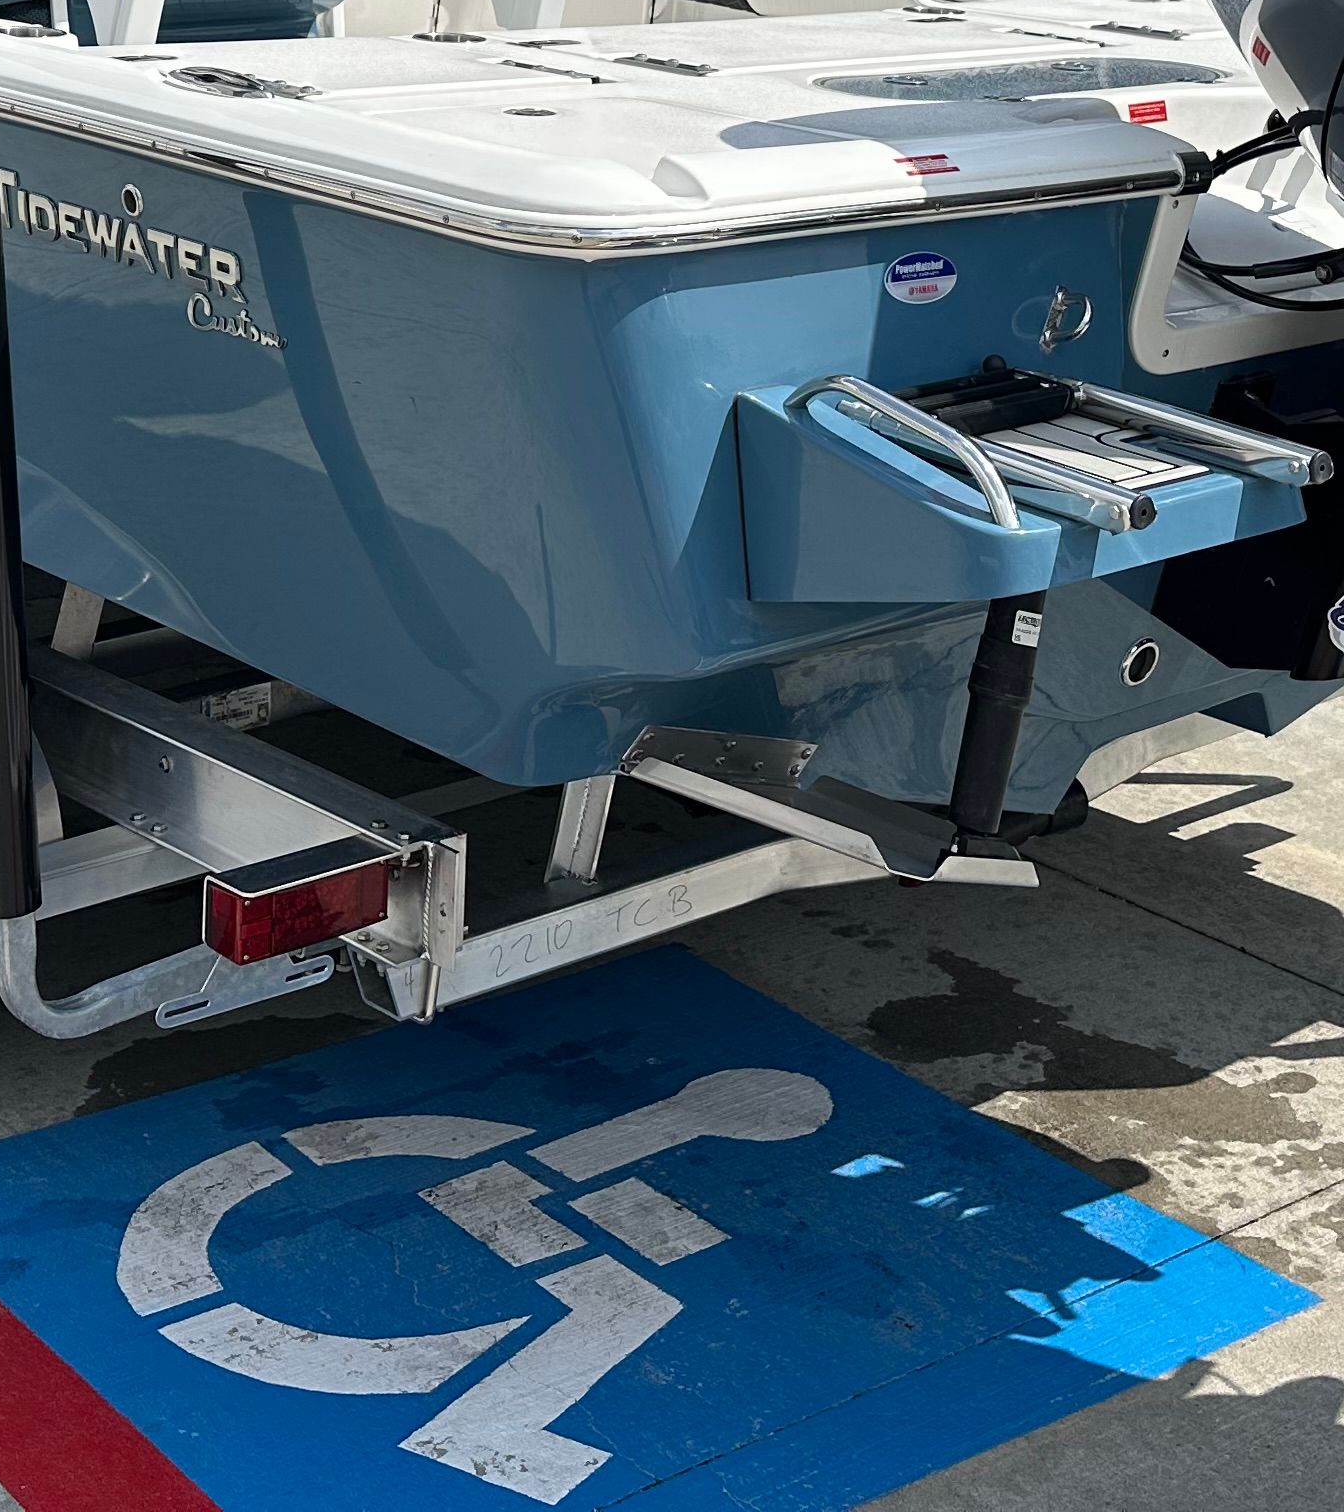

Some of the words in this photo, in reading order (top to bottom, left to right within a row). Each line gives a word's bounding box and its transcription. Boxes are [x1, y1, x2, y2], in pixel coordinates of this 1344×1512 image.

[0, 167, 248, 305] TIDEWATER
[186, 291, 288, 350] Custom
[489, 919, 574, 978] 2210
